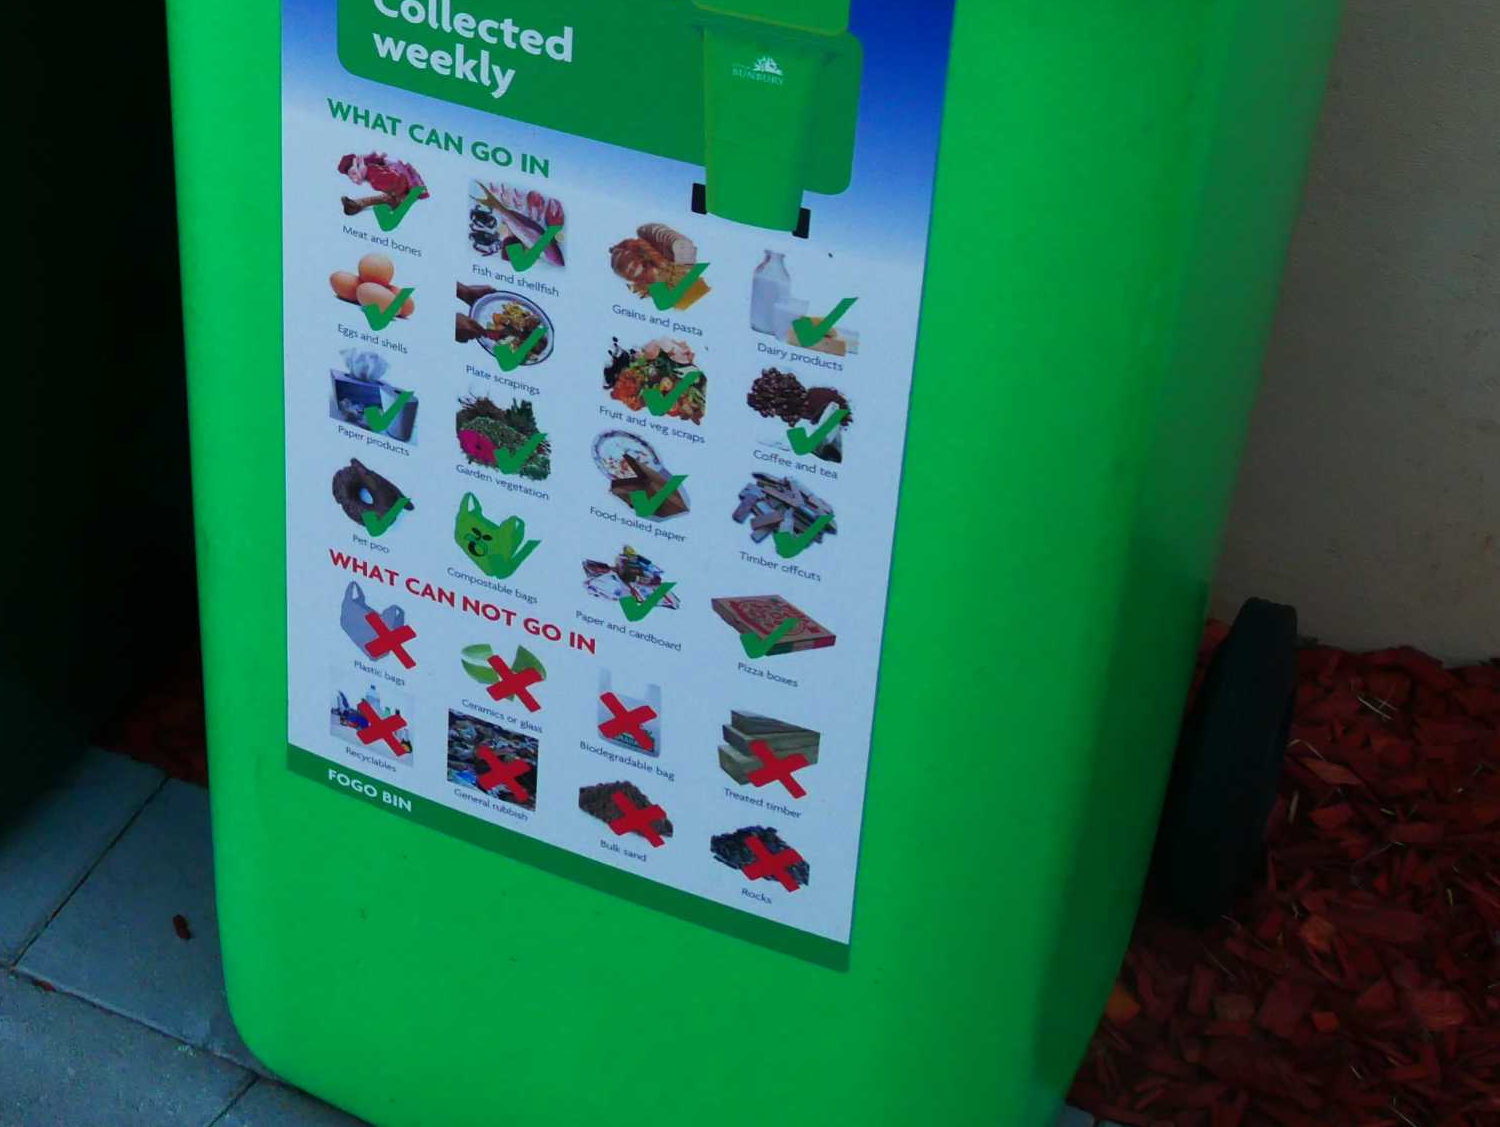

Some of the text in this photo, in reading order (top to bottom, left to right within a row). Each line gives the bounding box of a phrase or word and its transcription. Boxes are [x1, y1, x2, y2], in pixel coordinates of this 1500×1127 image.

[371, 31, 516, 100] weekly
[326, 98, 550, 178] WHAT CAN GO IN
[342, 225, 422, 258] Meat and bones
[472, 264, 560, 298] Fish and shellfish
[612, 304, 704, 337] Grains and pasta
[337, 323, 408, 354] Eggs and shells
[757, 342, 844, 371] Dairy products
[466, 364, 540, 396] Plate scrapings
[338, 425, 410, 457] Paper products
[599, 405, 706, 444] Fruit and veg scraps
[753, 448, 838, 480] Coffee and tea
[456, 464, 549, 500] Garden vegetation
[590, 505, 687, 543] Food-soiled paper
[352, 534, 390, 555] Pet poo
[739, 551, 821, 582] Timber offcuts
[328, 548, 597, 655] WHAT CAN NOT GO IN
[447, 566, 538, 605] Compostable bags
[576, 610, 682, 652] Paper and cardboard
[354, 660, 405, 687] Plastic bags
[738, 662, 799, 688] Pizza boxes
[461, 698, 543, 734] Ceramics or glass
[346, 746, 397, 773] Recyclables
[580, 740, 675, 782] Biodegradable bag
[329, 769, 412, 813] FOGO BIN
[454, 787, 529, 821] General rubbish
[724, 787, 802, 818] Treated timber
[600, 840, 647, 863] Bulk sand
[741, 887, 772, 905] Rocks
